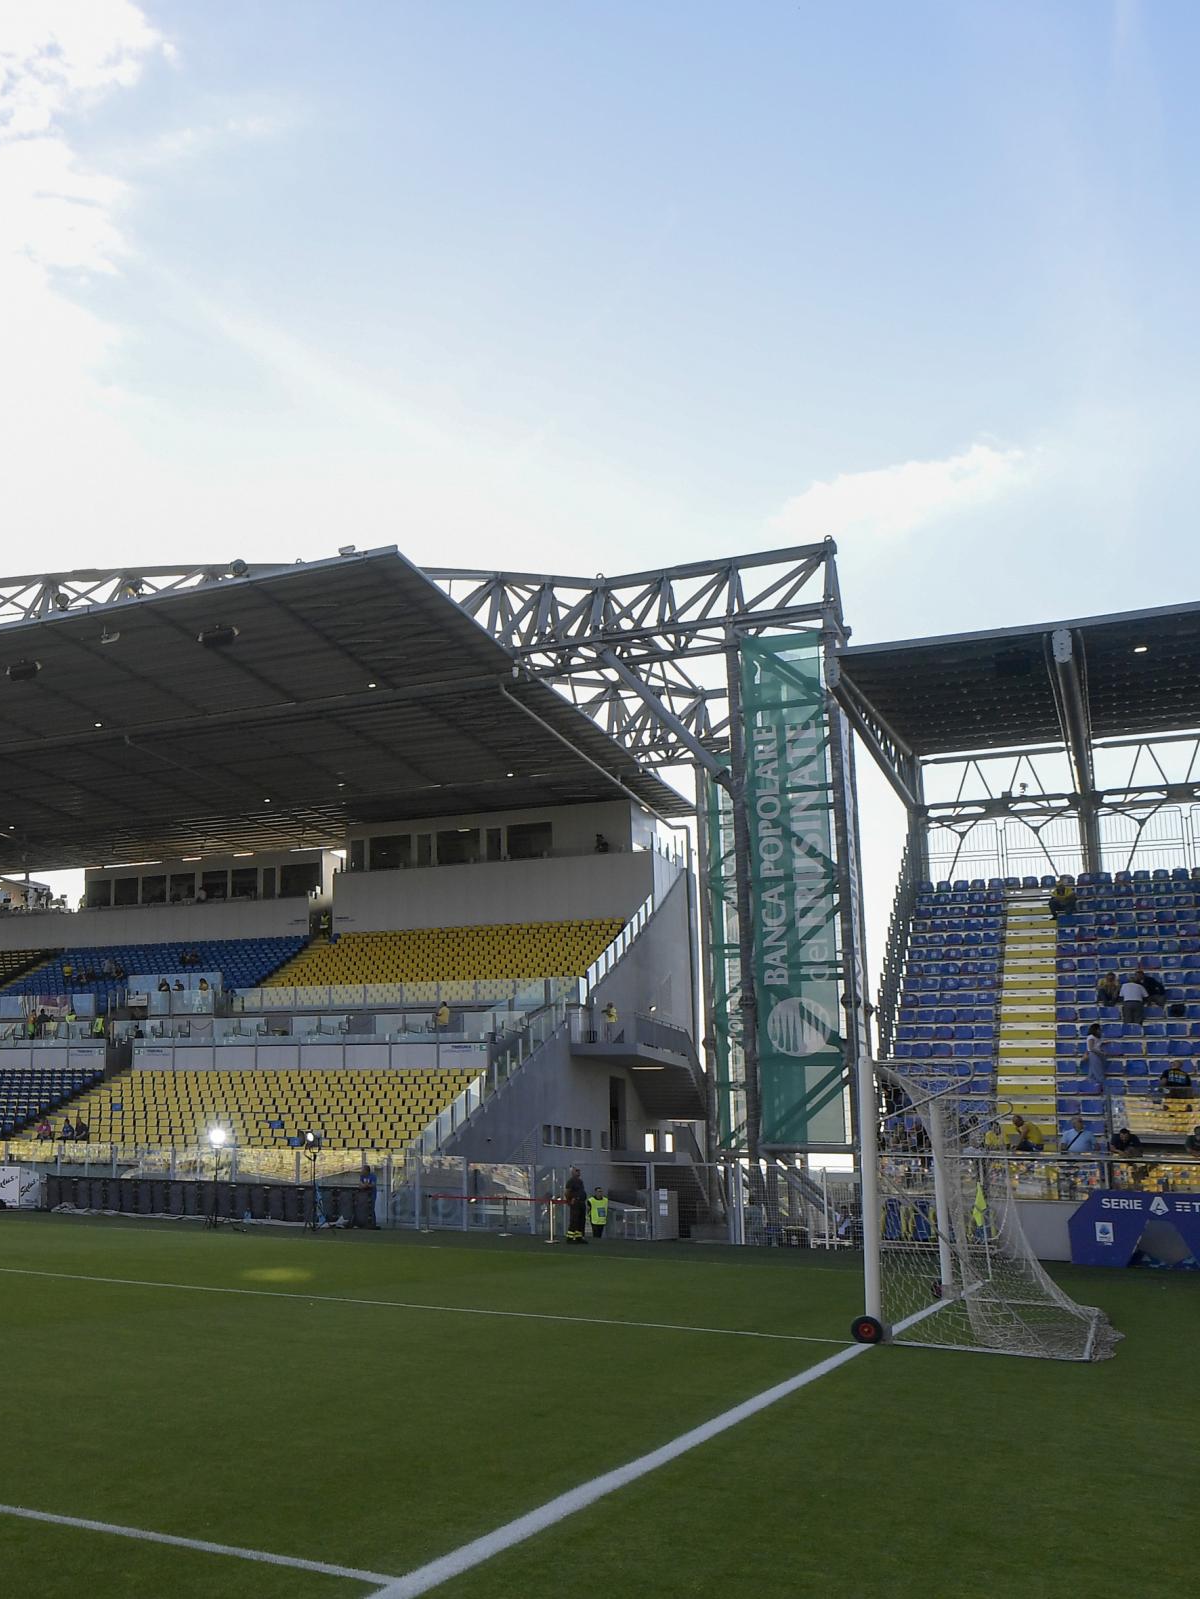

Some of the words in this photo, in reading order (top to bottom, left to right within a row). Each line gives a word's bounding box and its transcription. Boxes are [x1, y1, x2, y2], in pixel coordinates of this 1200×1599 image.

[752, 724, 785, 878] POPOLARE
[785, 719, 828, 927] FRUSINATE
[761, 883, 789, 986] BANCA
[800, 937, 830, 983] del
[1102, 1198, 1142, 1210] SERIE
